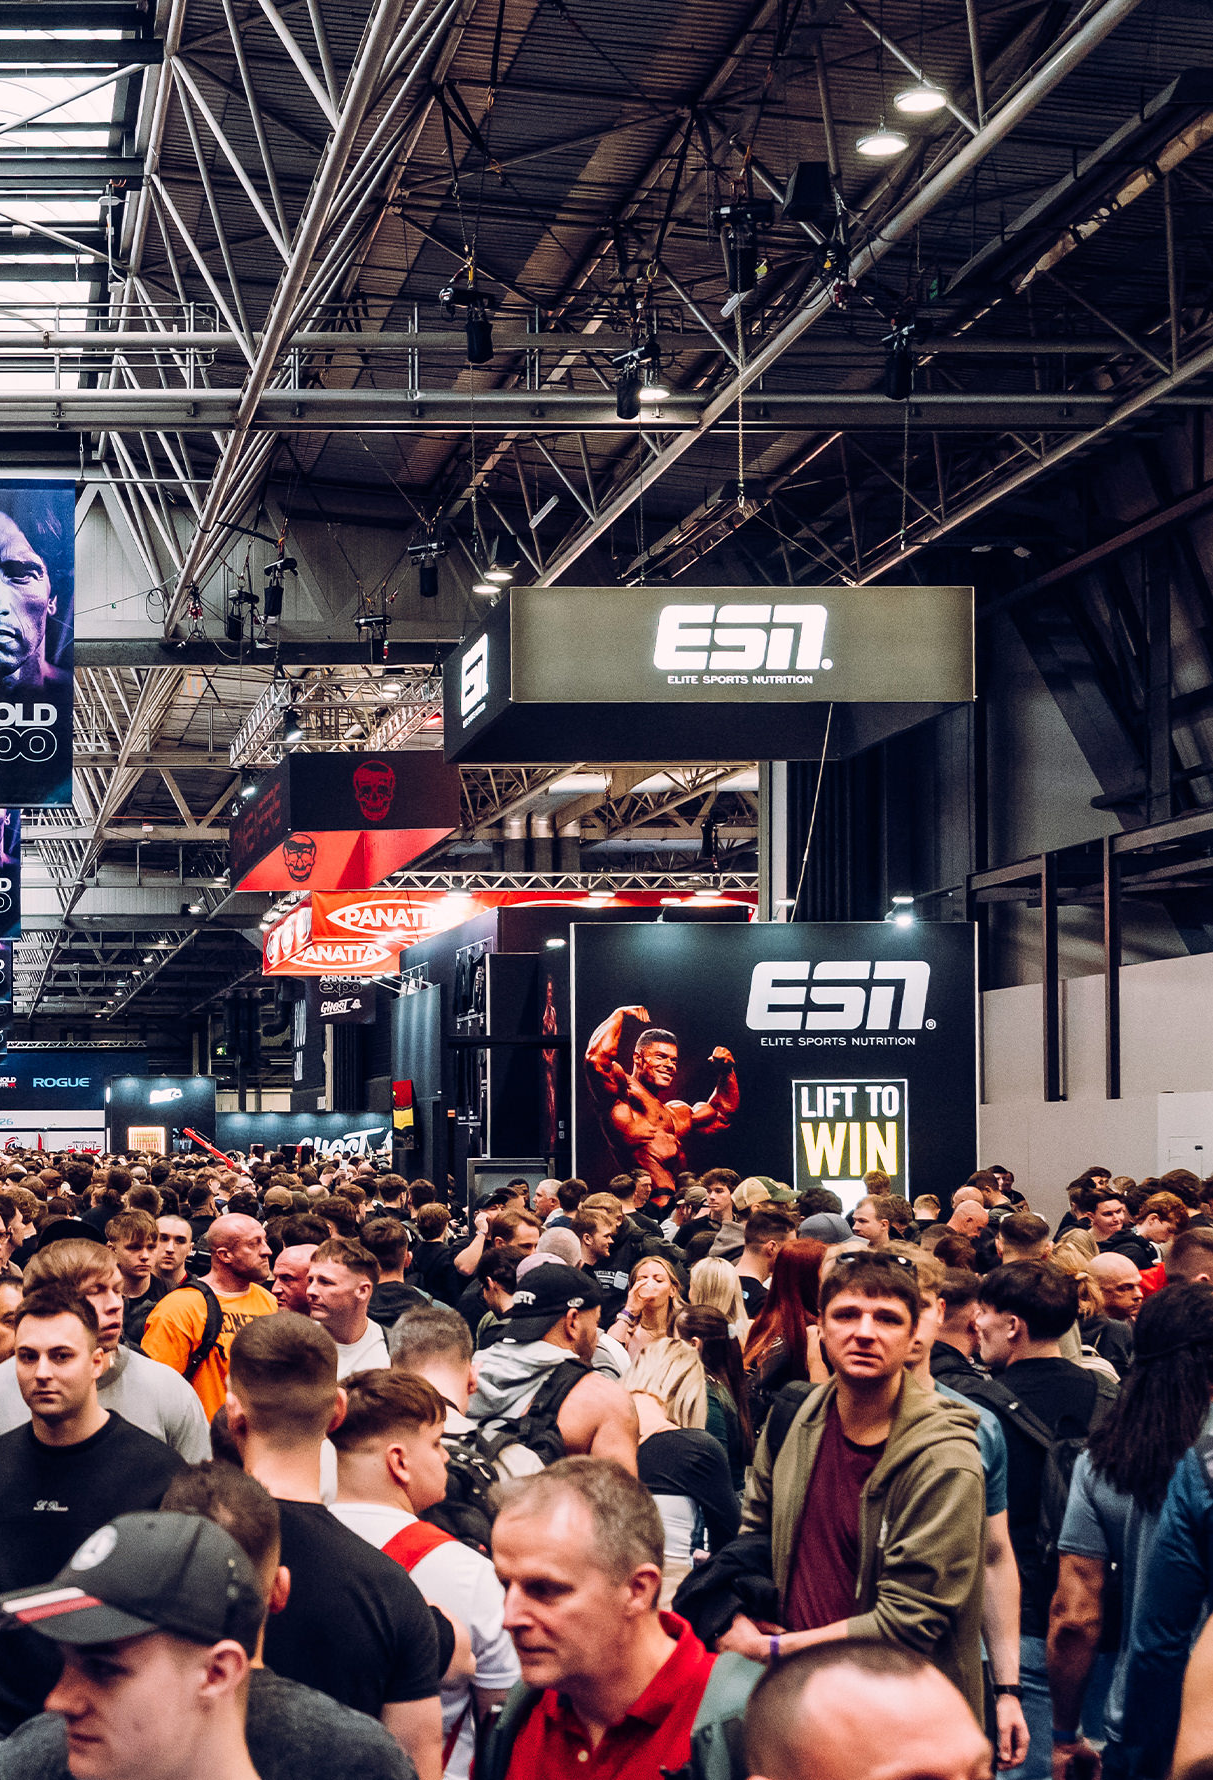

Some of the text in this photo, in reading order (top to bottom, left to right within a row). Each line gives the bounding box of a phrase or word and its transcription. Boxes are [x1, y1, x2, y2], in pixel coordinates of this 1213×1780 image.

[667, 675, 814, 685] ELITE SPORTS NUTRITION
[320, 975, 363, 983] ARNOLD
[319, 982, 362, 997] expo
[745, 960, 932, 1031] ESN
[320, 999, 353, 1016] GHOST
[761, 1036, 916, 1046] ELITE SPORTS NUTRITION
[33, 1077, 91, 1088] ROGUE
[801, 1085, 900, 1118] LIFT TO
[800, 1121, 898, 1177] WIN
